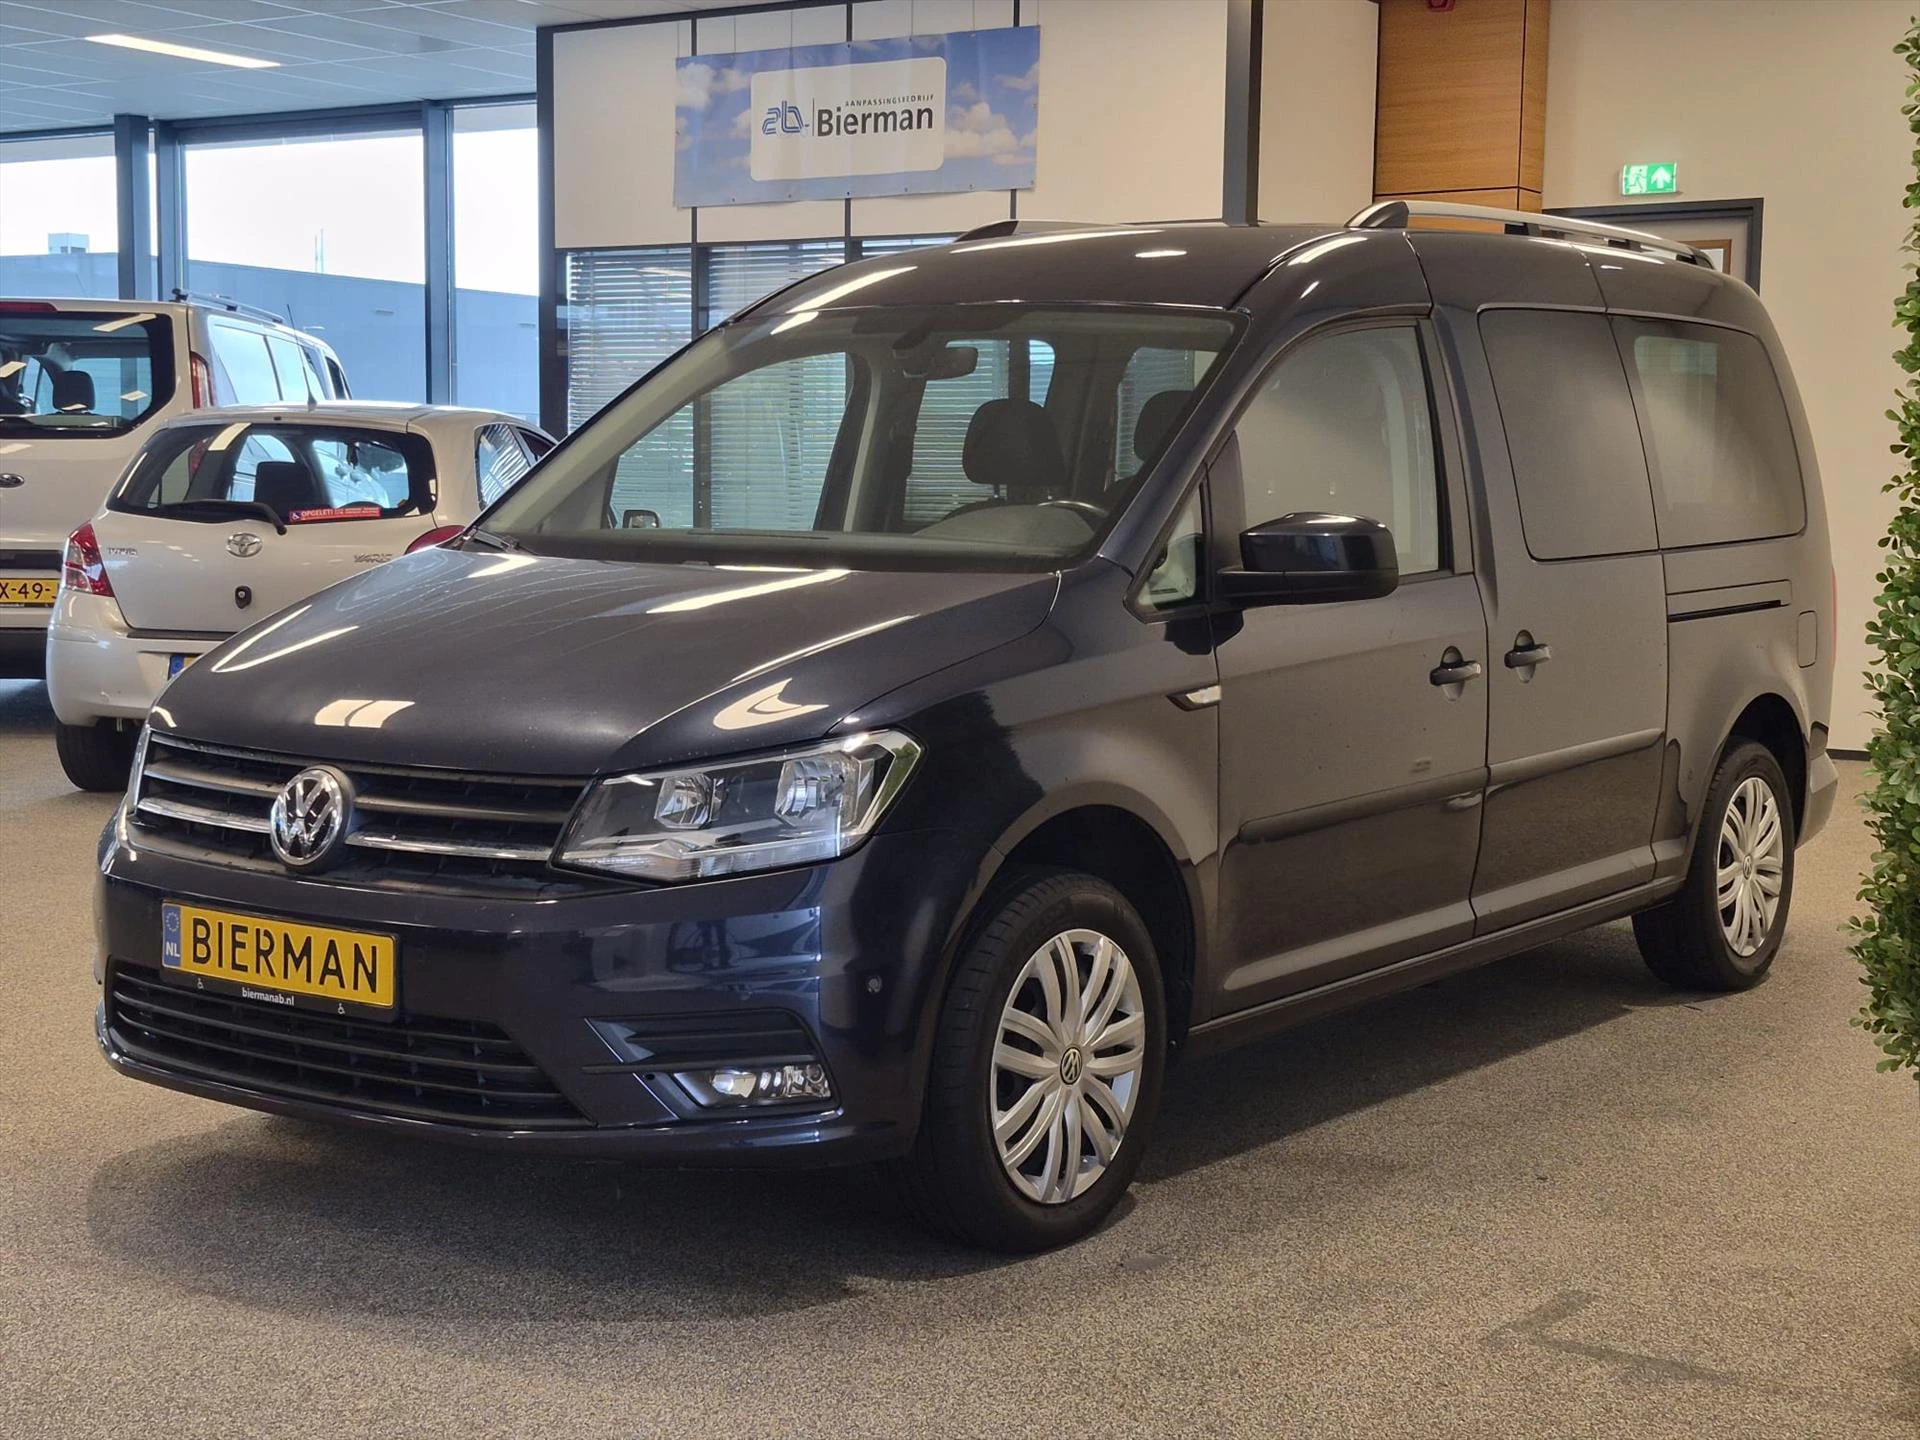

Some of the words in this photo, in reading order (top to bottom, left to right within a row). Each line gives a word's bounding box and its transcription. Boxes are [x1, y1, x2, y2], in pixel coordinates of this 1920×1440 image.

[817, 106, 933, 137] Bierman
[0, 582, 57, 600] X-49-
[165, 941, 181, 958] NL
[192, 917, 377, 994] BIERMAN
[241, 987, 295, 1006] biermanab.nl
